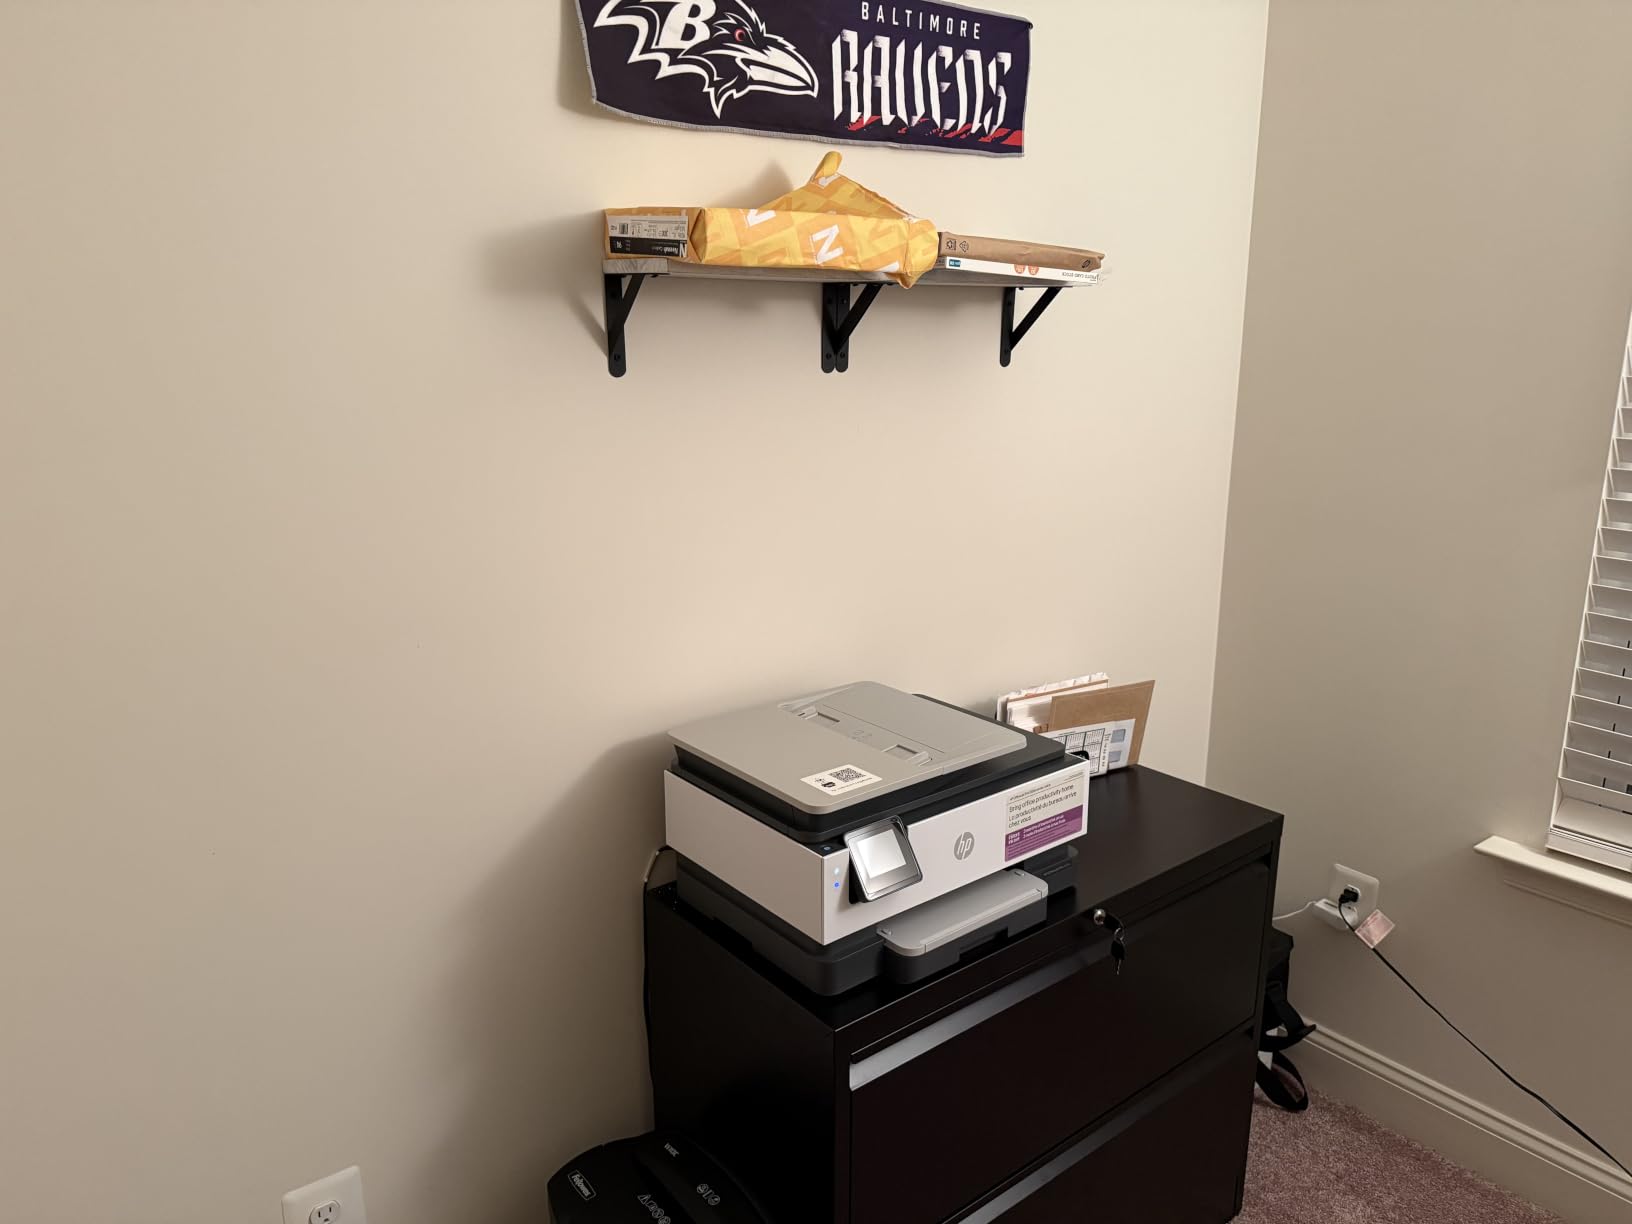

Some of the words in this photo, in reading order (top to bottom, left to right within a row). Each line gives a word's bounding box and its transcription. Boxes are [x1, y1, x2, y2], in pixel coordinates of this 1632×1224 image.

[659, 0, 716, 49] B
[861, 1, 982, 40] BALTIMORE
[831, 29, 1013, 136] RAVENS
[1009, 803, 1022, 813] Bring
[1022, 799, 1036, 808] office
[1036, 789, 1061, 803] productivity
[1062, 784, 1074, 792] home
[1020, 815, 1032, 824] vous
